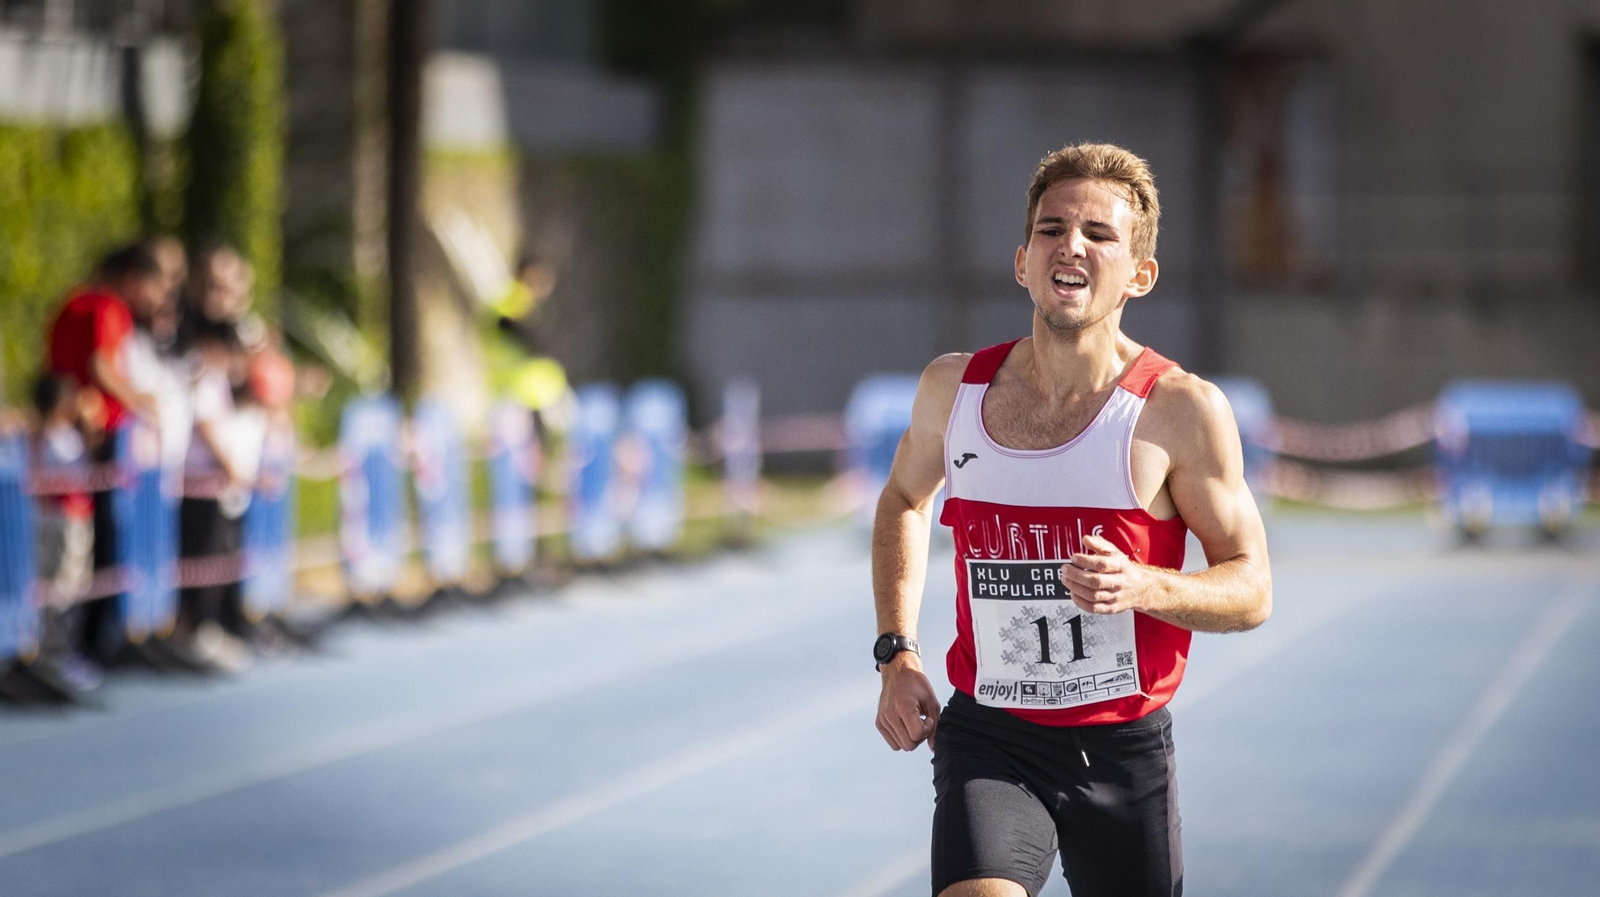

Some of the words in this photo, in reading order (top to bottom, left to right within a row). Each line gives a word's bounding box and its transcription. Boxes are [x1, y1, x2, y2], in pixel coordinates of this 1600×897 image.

[977, 567, 1010, 581] XLV
[979, 583, 1056, 597] POPULAR
[1029, 614, 1091, 665] 11
[978, 680, 1018, 702] enjoy!
